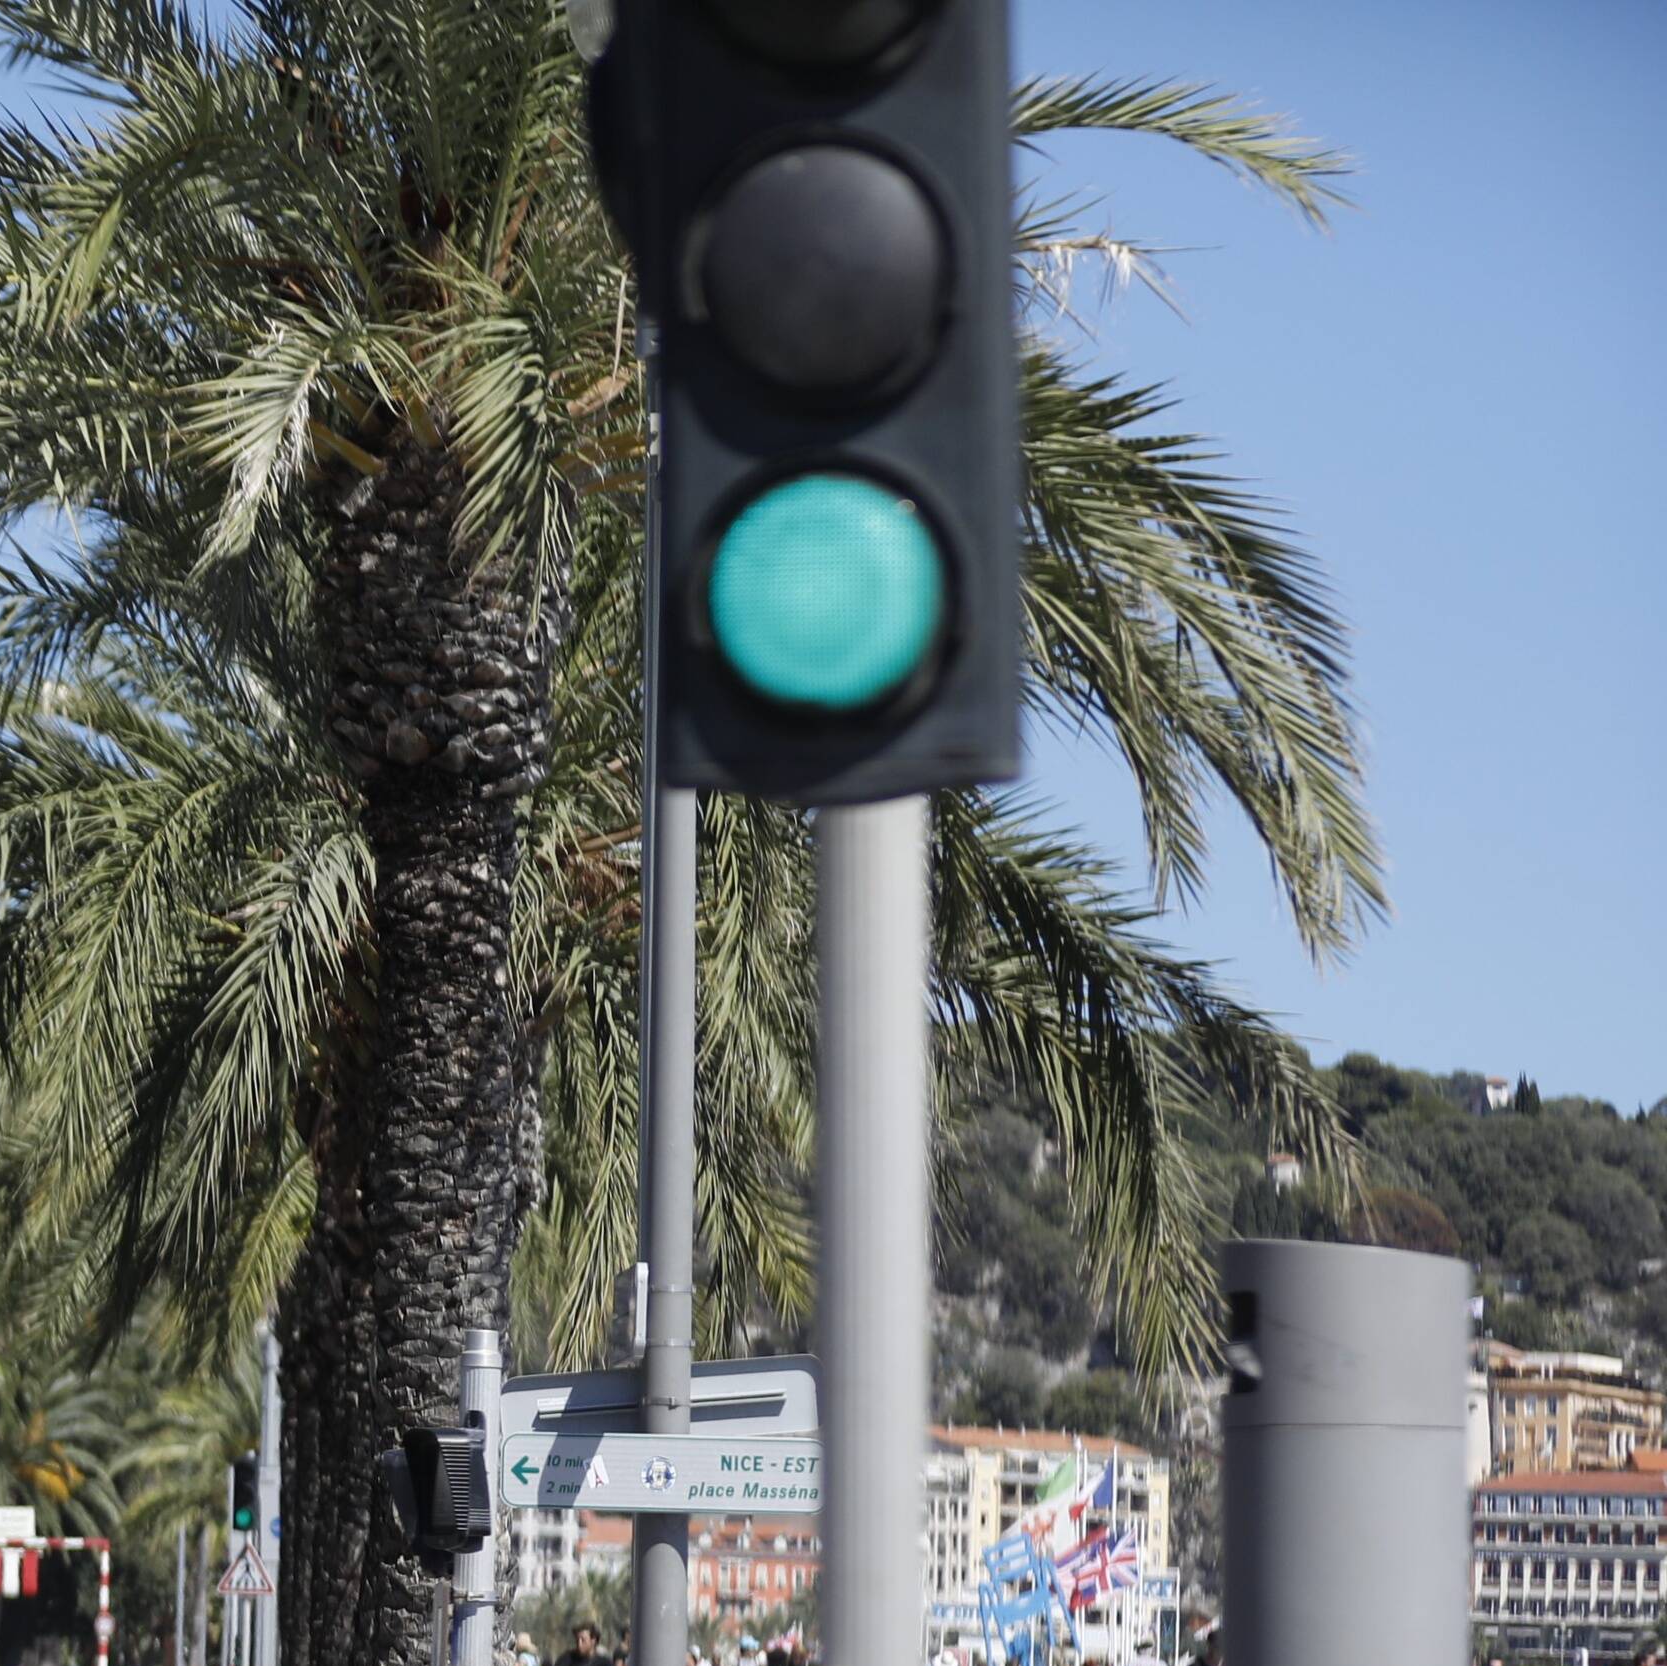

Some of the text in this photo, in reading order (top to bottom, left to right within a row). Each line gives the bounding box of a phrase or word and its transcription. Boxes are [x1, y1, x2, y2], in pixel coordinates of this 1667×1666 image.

[546, 1455, 561, 1467] 10
[720, 1455, 764, 1472] NICE
[783, 1457, 820, 1473] EST
[546, 1481, 581, 1494] 2 min
[688, 1481, 819, 1500] place Masséna
